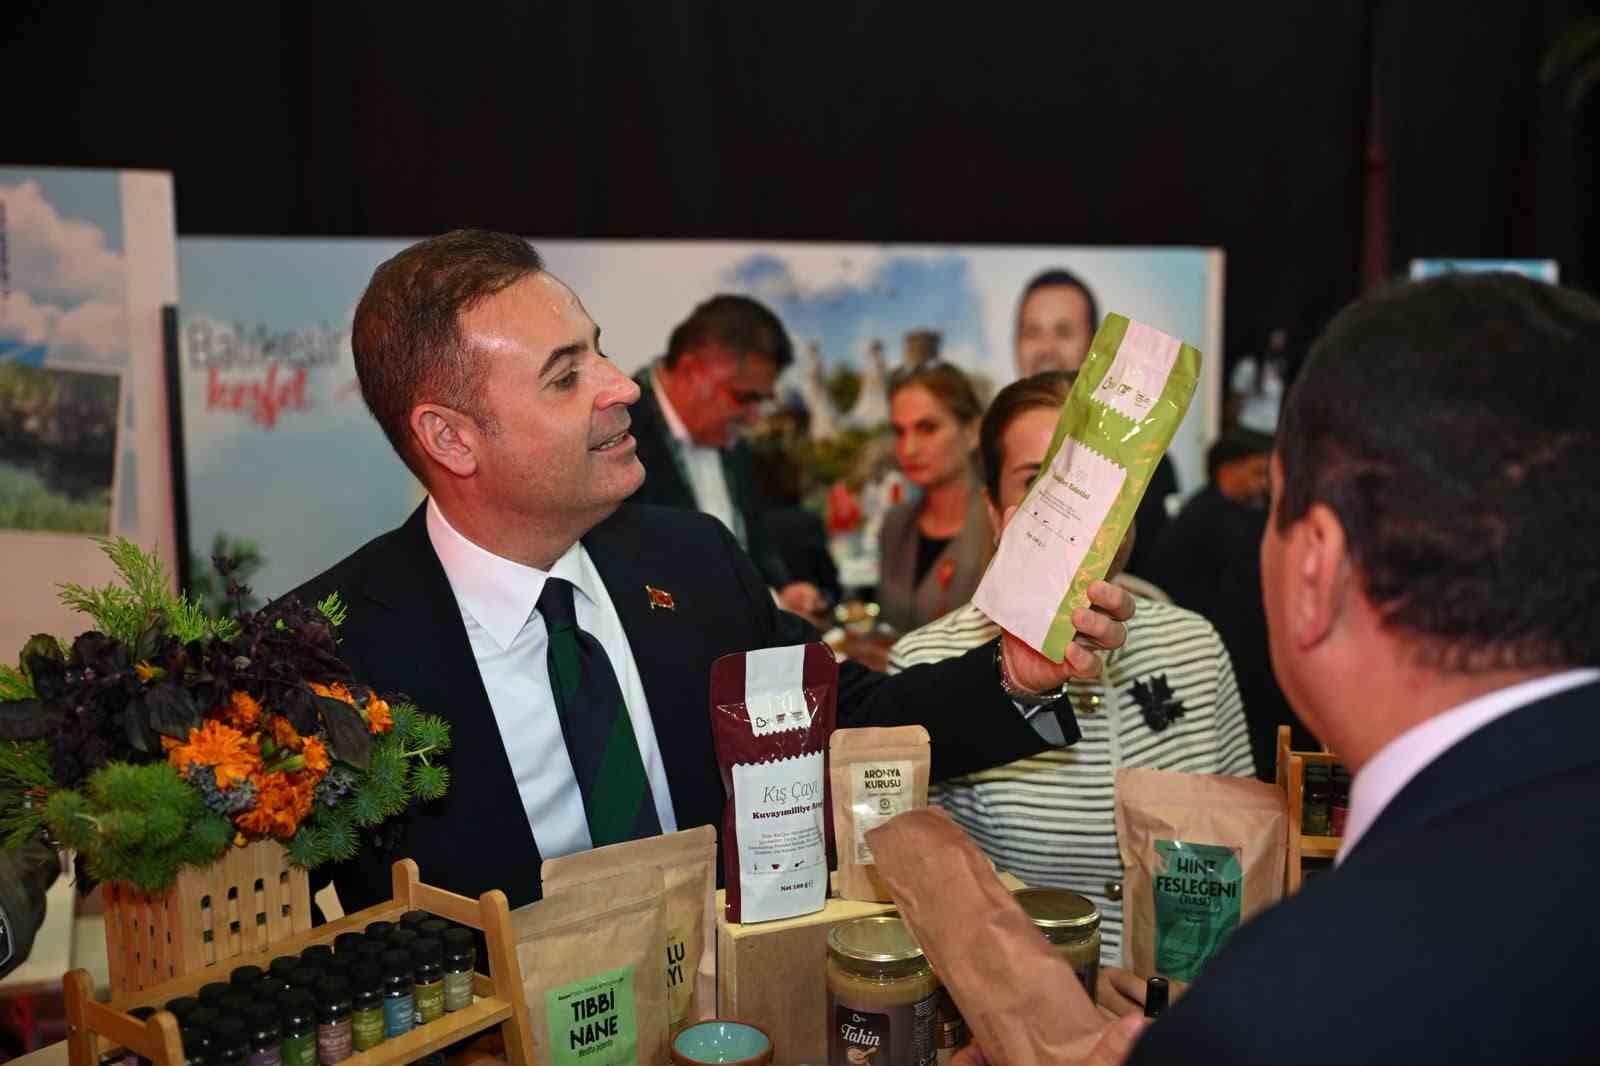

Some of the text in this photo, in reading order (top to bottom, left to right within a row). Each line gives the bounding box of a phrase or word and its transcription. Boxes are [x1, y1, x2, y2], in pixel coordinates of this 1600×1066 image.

[864, 768, 901, 779] ARONYA
[763, 785, 787, 804] Kış
[864, 779, 902, 790] KURUSU
[666, 964, 684, 988] YI
[569, 1014, 619, 1050] NANE
[840, 1023, 881, 1047] Tahin
